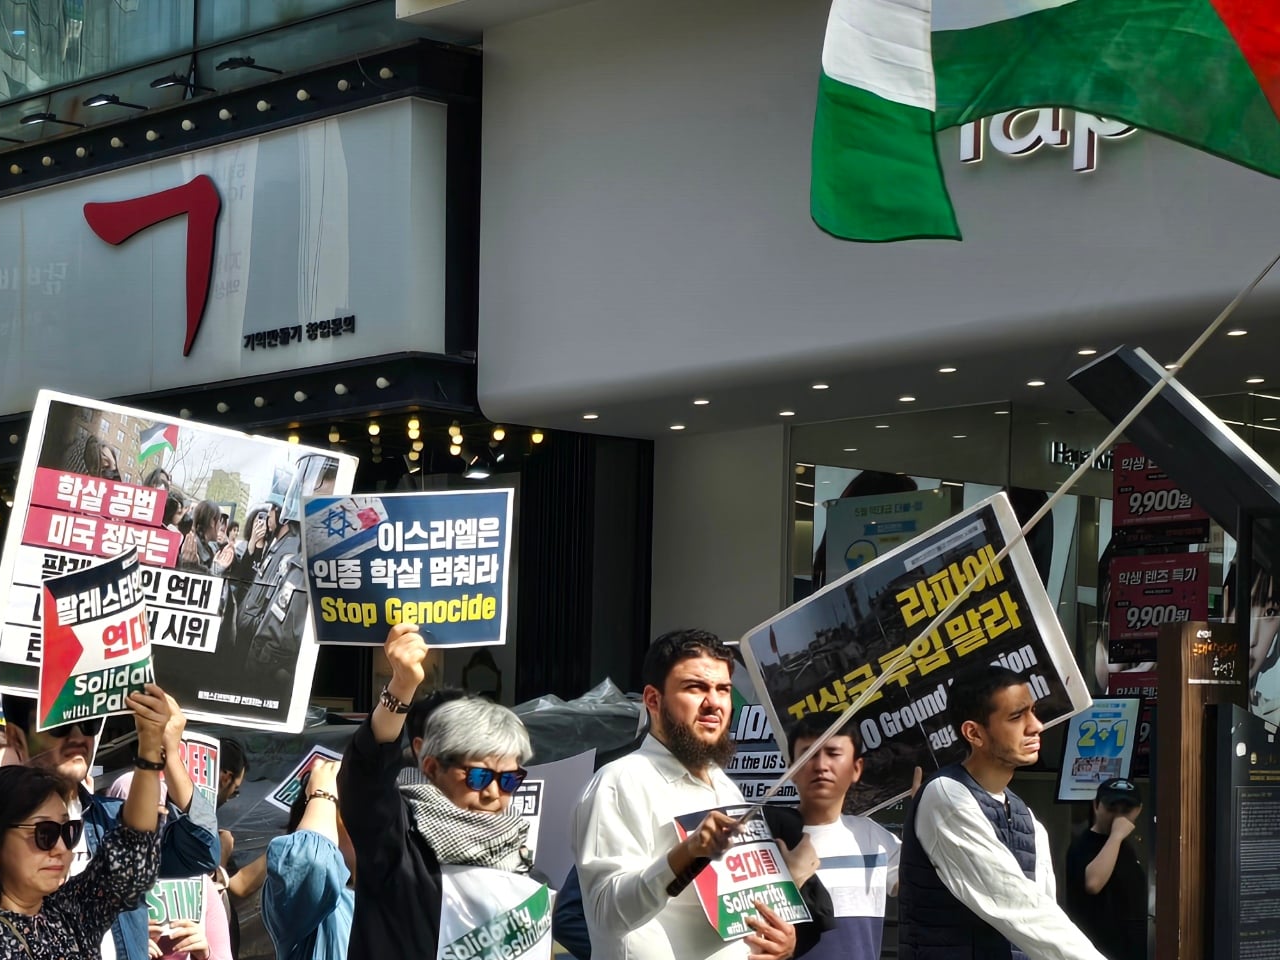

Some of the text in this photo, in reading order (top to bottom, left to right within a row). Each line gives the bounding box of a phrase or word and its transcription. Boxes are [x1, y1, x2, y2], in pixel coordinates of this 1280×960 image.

[56, 473, 159, 522] 학살 공범
[47, 513, 171, 565] 미국 정부는
[376, 517, 500, 553] 이스라엘은
[312, 553, 500, 590] 인종 학살 멈춰라
[895, 543, 1005, 629] 라파에
[166, 572, 214, 611] 연대
[320, 592, 497, 628] Stop Genocide
[161, 611, 210, 648] 시위
[877, 626, 950, 688] 투입
[944, 591, 1023, 658] 말라
[62, 704, 90, 720] with
[880, 682, 949, 738] Ground
[741, 754, 761, 770] the
[762, 754, 778, 770] US
[722, 883, 787, 914] Solidarity
